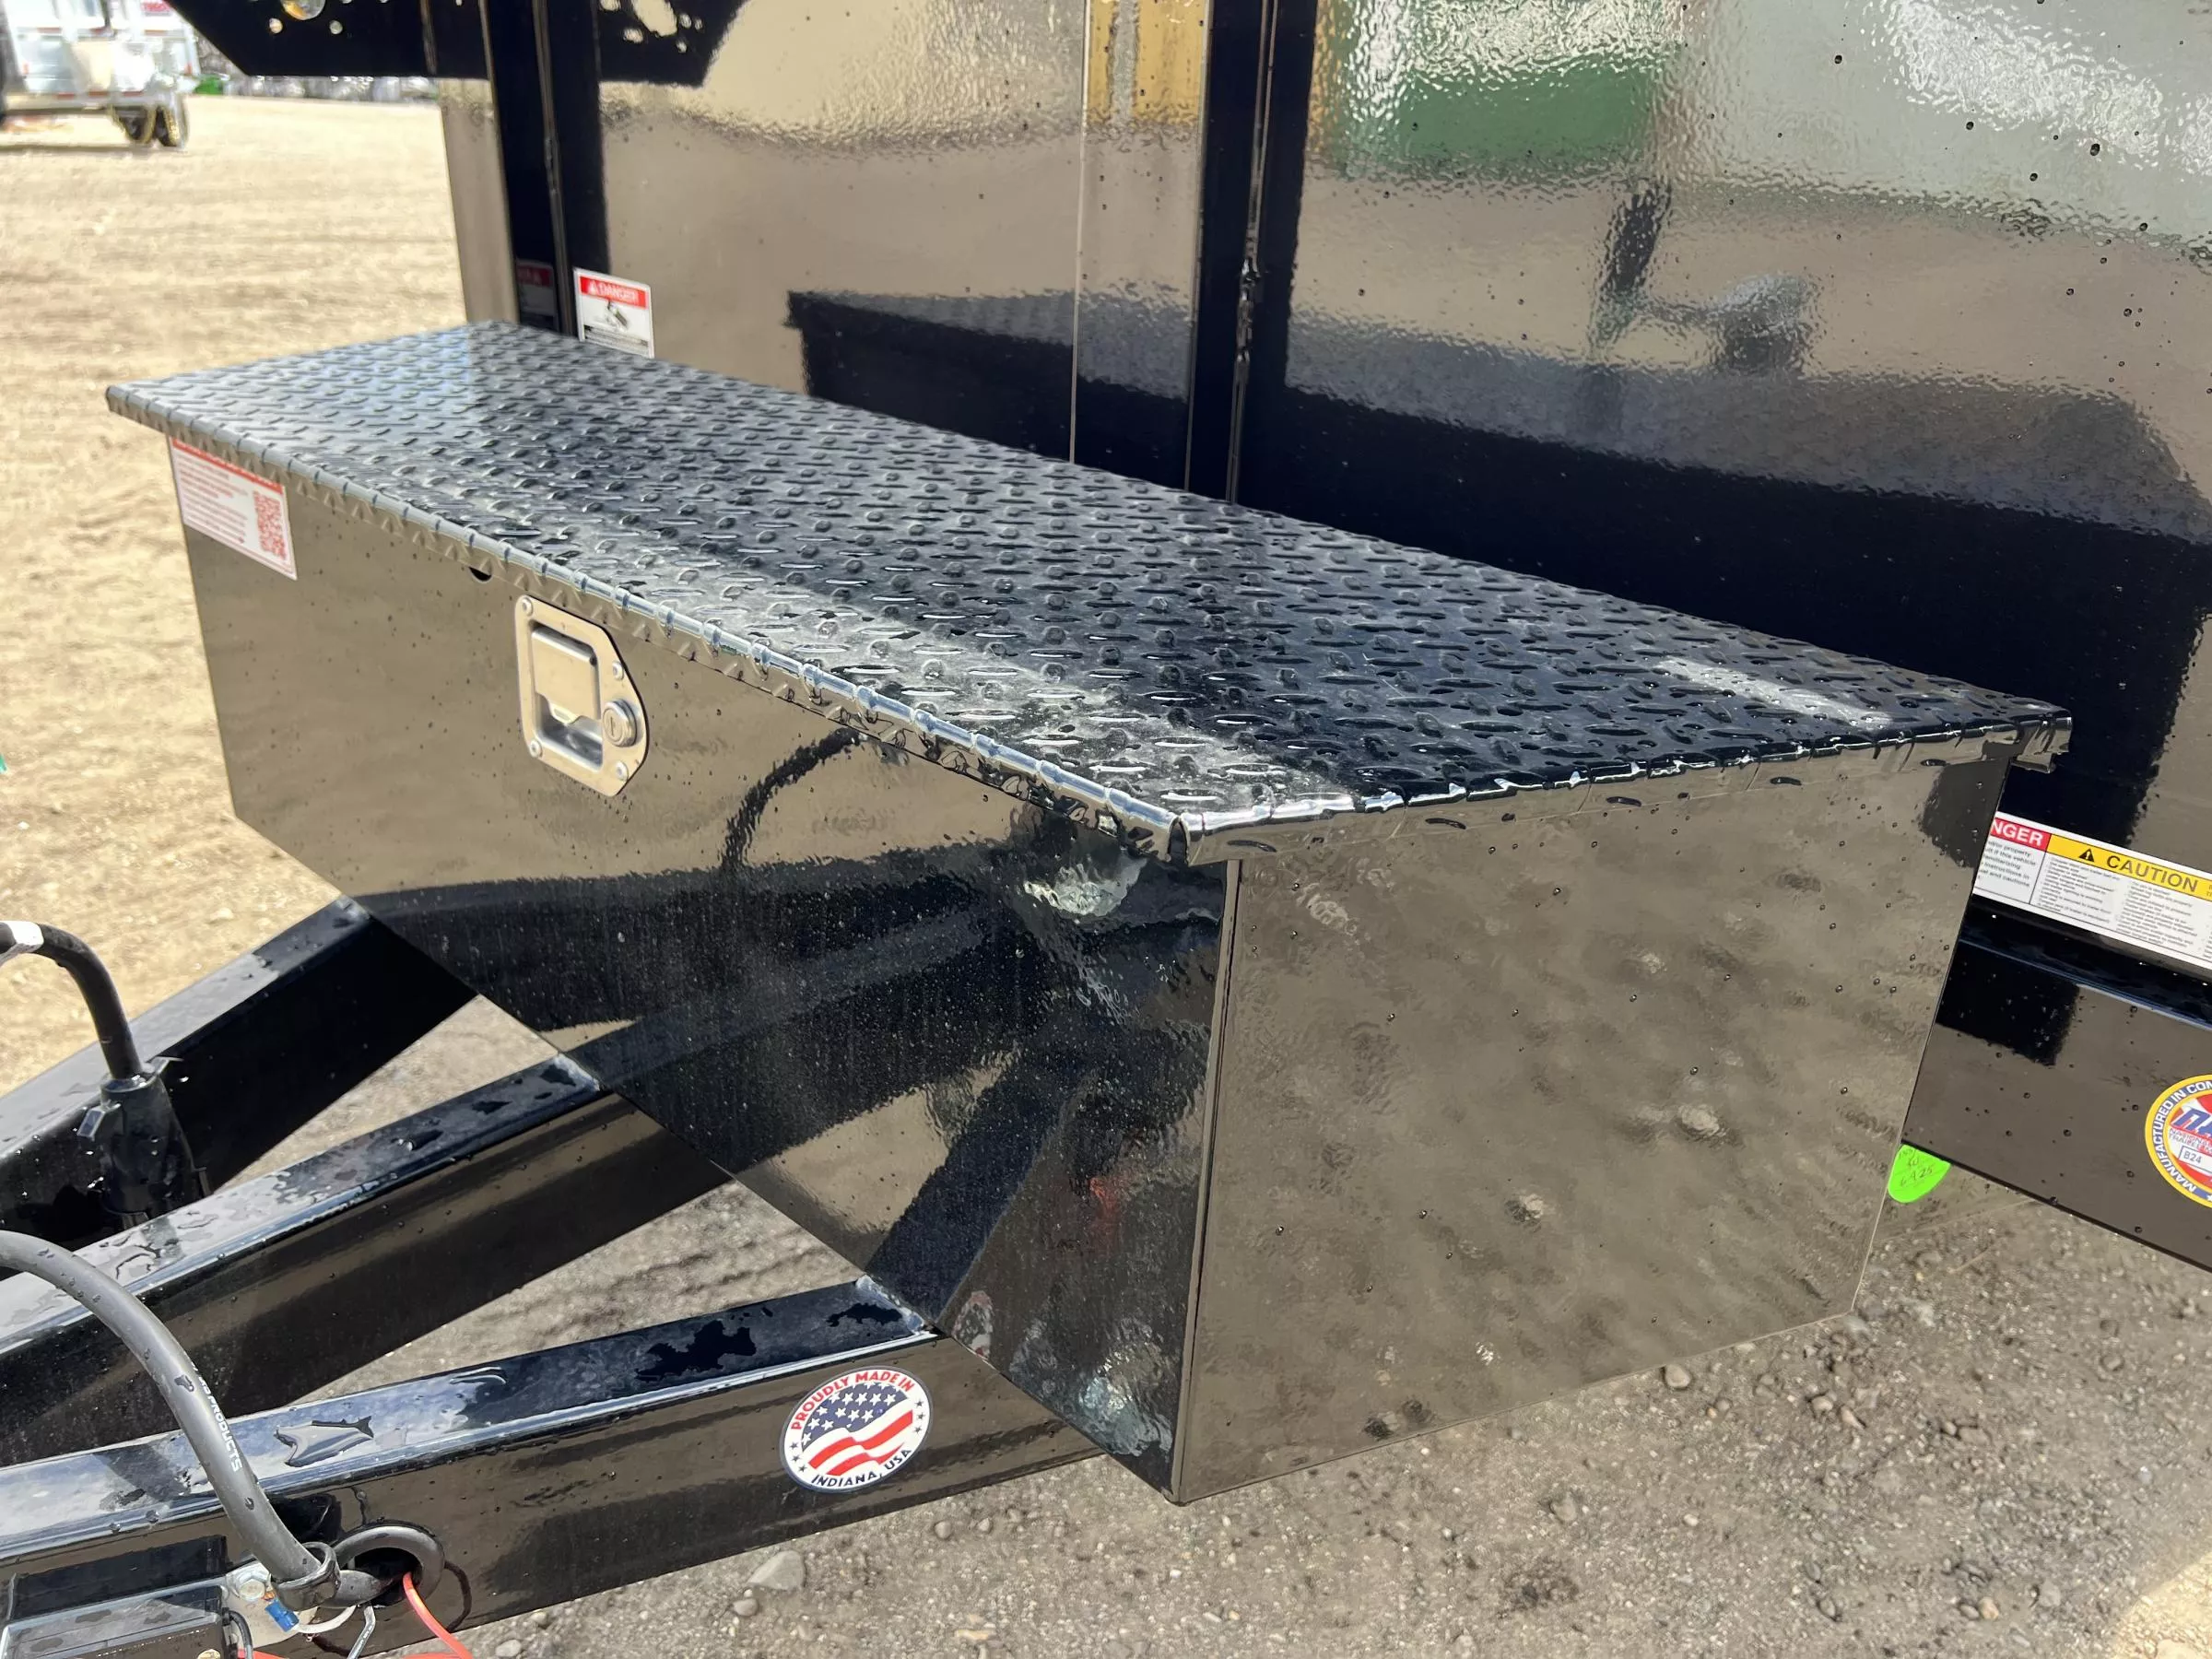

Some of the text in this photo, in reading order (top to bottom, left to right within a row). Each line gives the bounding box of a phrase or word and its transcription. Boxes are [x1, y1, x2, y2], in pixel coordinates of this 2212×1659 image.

[598, 282, 639, 304] DANGER
[1991, 819, 2043, 846] NGER
[2106, 855, 2198, 892] CAUTION
[2171, 1089, 2187, 1101] IN
[2153, 1099, 2197, 1194] MANUFACTURED
[2183, 1150, 2202, 1164] B24
[792, 1371, 915, 1430] PROUDLY MADE IN
[207, 1394, 243, 1472] PRODUCTS
[811, 1449, 912, 1487] INDIANA, USA
